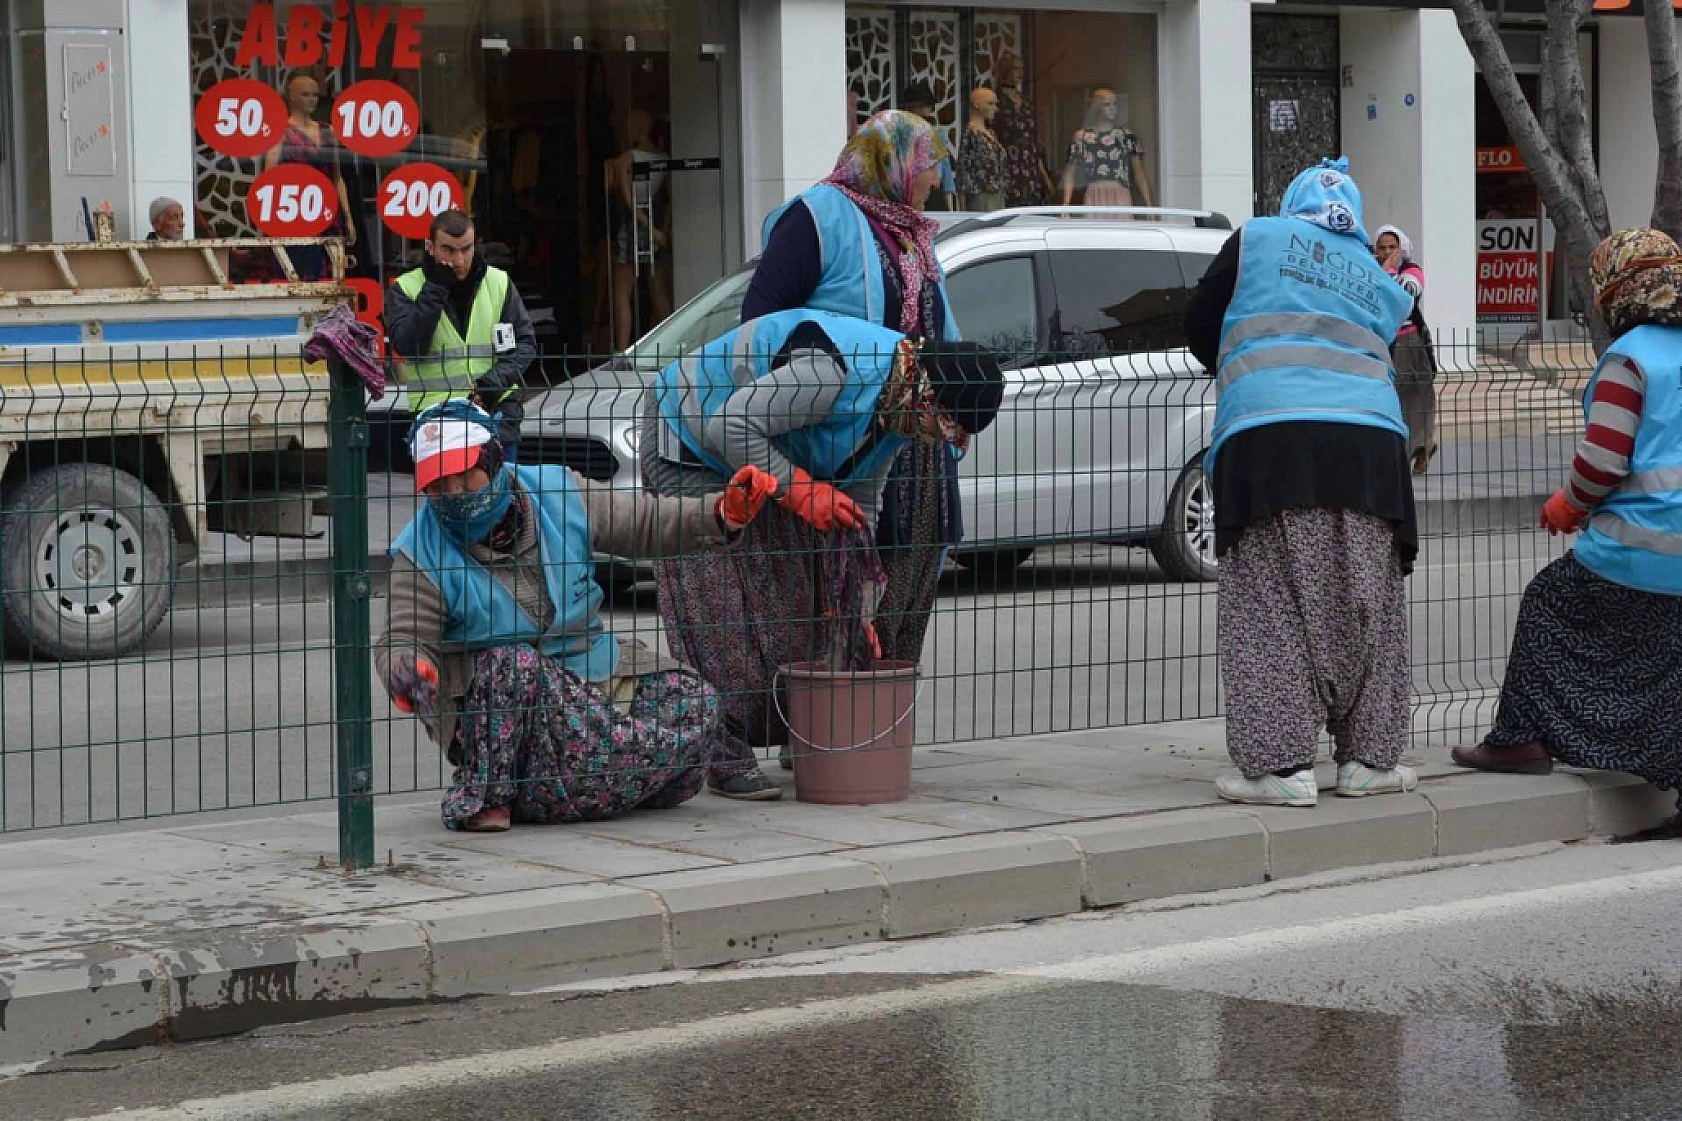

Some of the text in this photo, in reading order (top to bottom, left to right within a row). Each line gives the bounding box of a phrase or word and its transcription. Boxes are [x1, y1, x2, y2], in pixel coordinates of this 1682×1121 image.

[1477, 150, 1512, 166] FLO
[1479, 226, 1534, 251] SON
[1480, 258, 1538, 279] BÜYÜK
